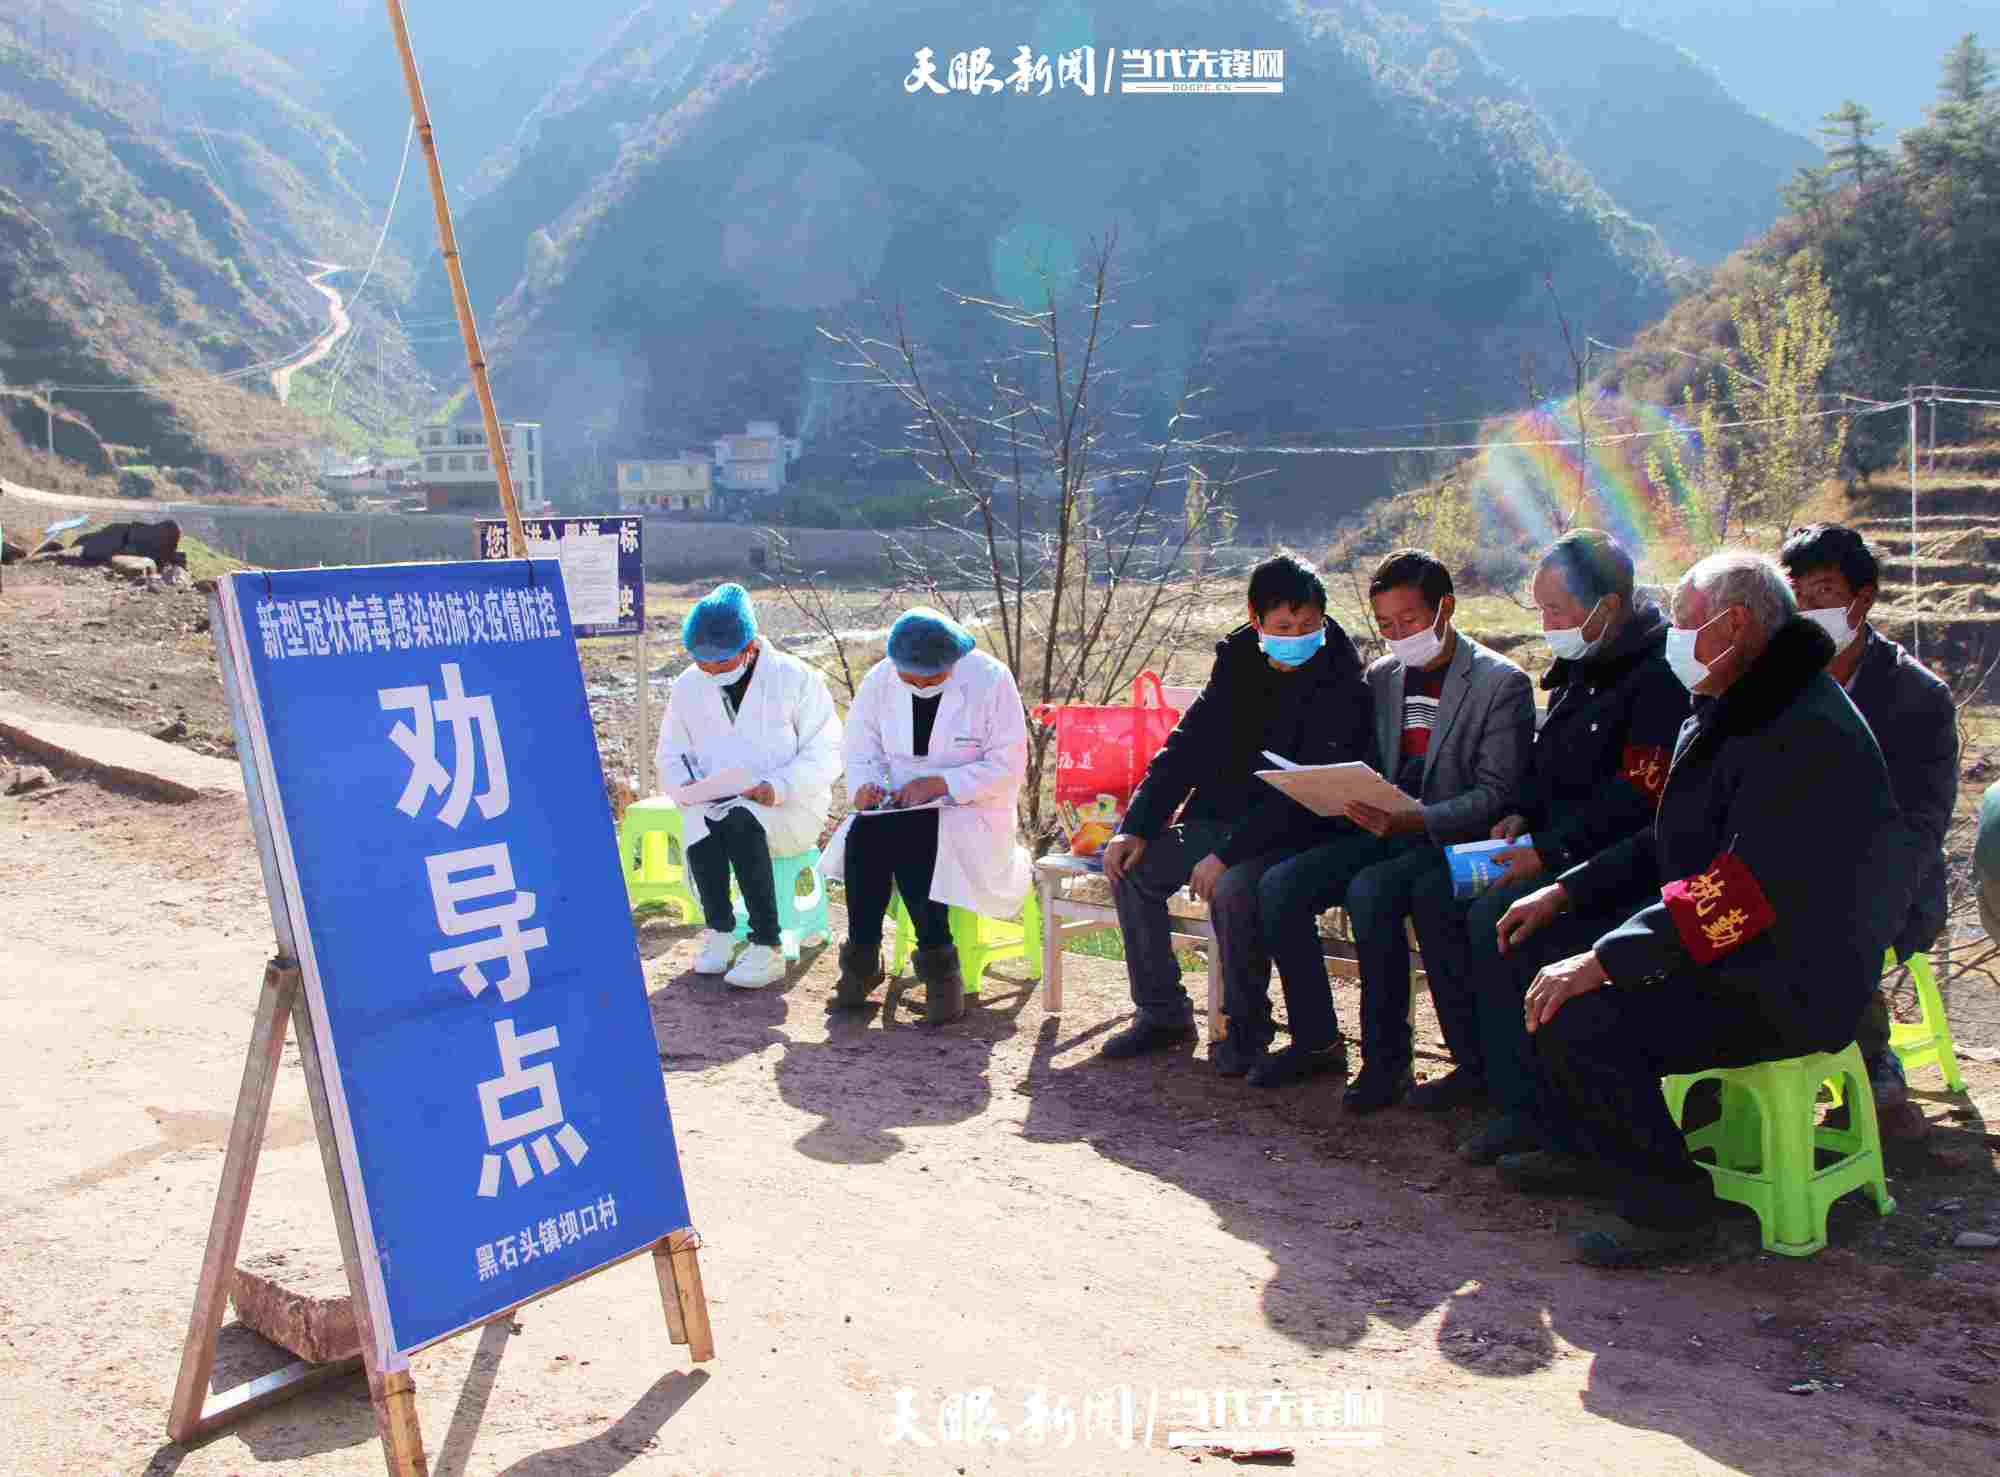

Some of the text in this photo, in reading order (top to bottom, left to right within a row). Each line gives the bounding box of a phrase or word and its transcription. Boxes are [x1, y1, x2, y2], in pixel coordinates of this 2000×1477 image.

[256, 586, 561, 659] 新型冠状病毒感染的肺炎疫情防控
[377, 662, 590, 1198] 劝导点
[475, 1193, 618, 1281] 黑石头镇坝口村
